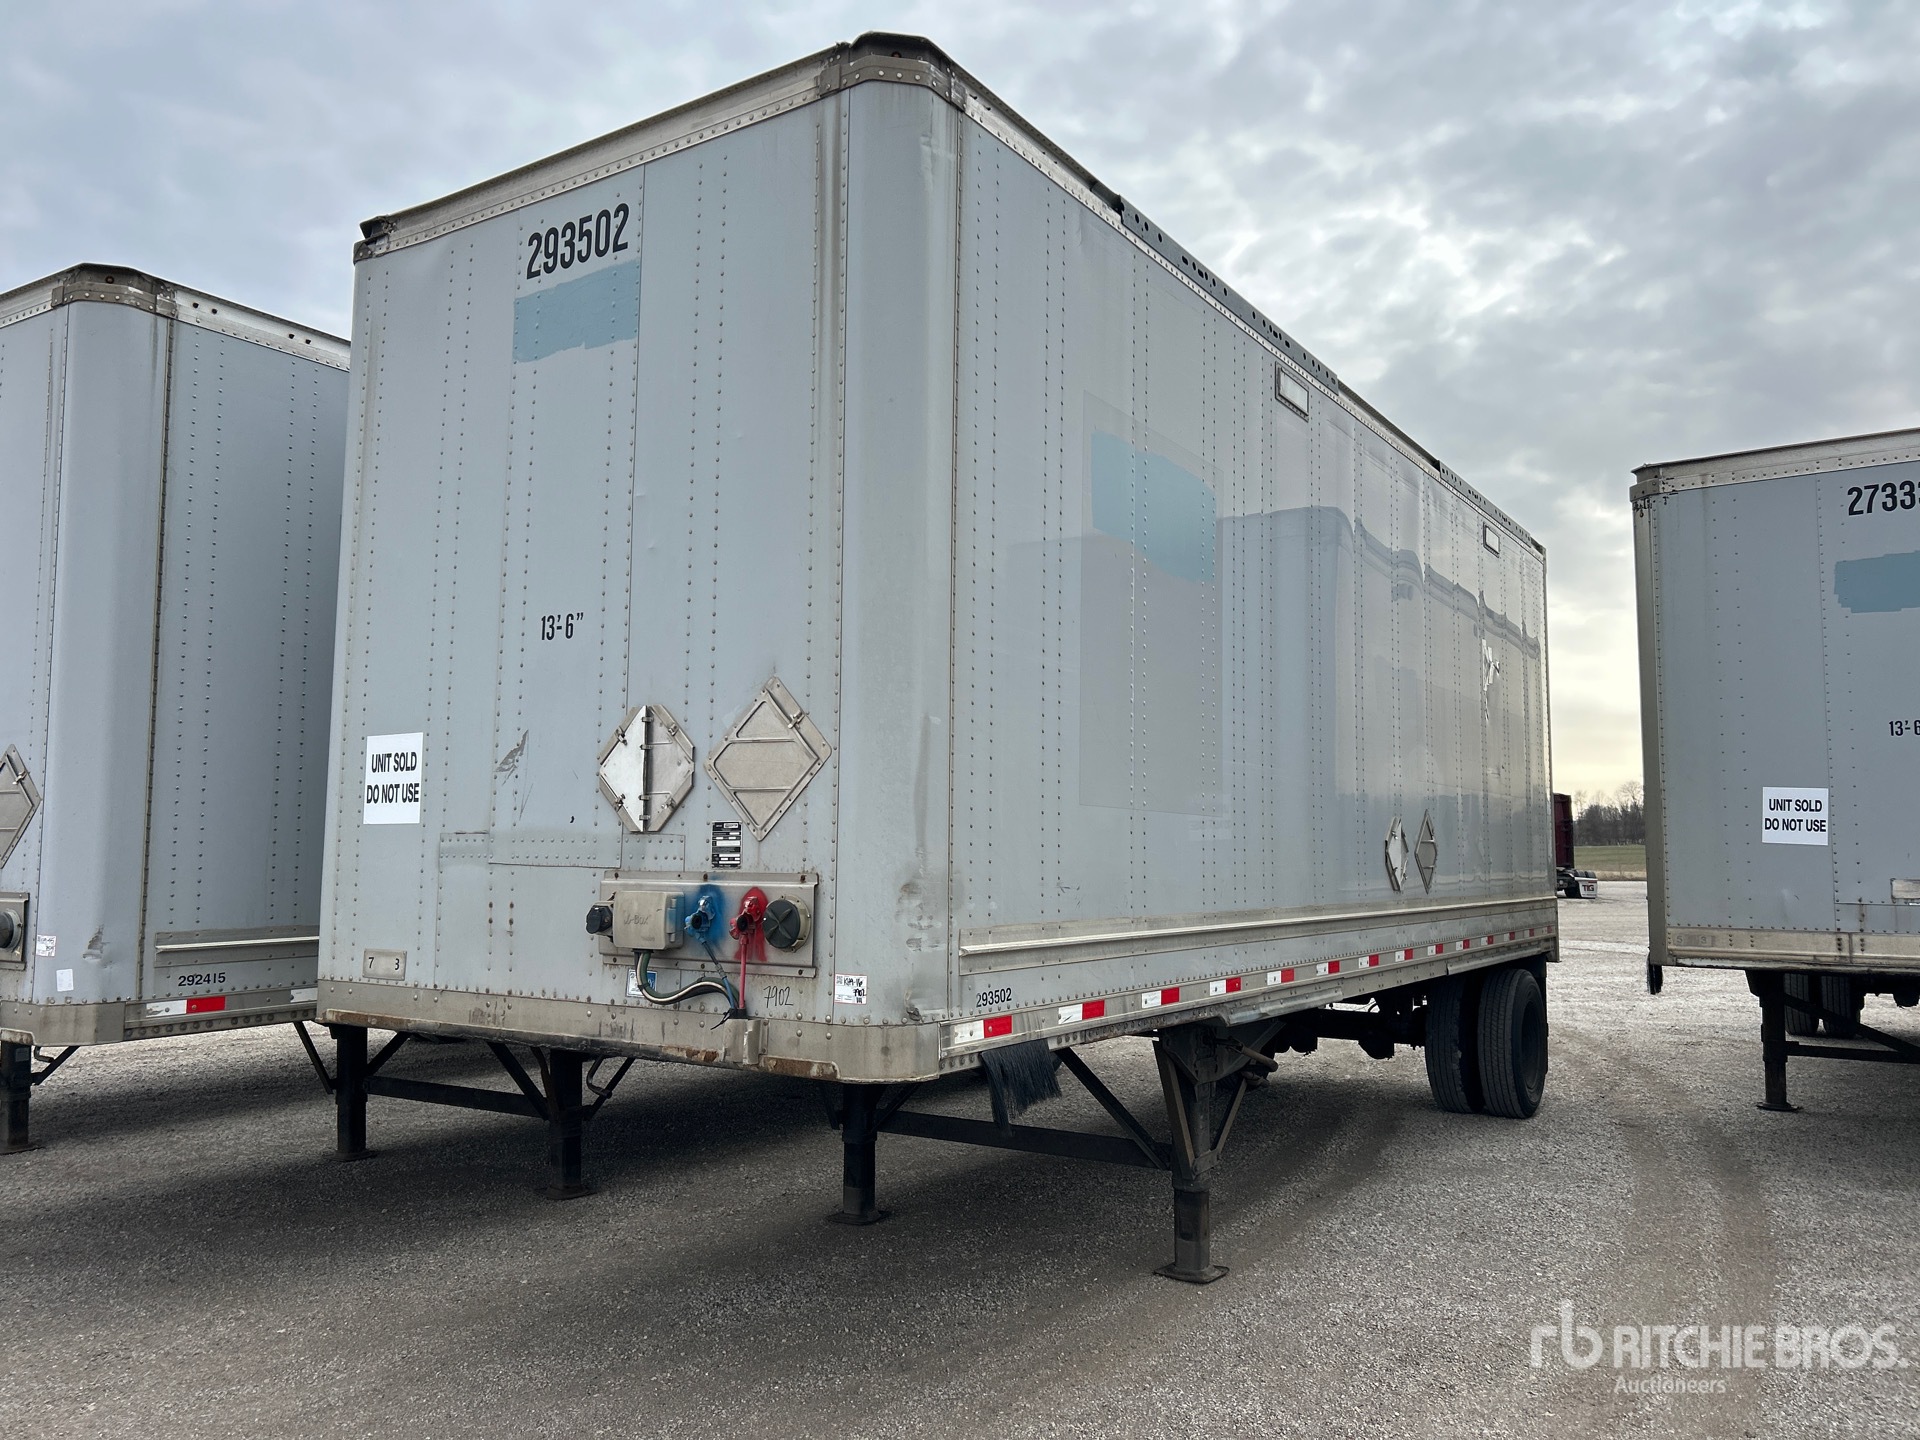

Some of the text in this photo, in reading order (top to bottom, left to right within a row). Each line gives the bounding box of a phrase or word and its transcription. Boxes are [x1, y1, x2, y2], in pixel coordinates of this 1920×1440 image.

[526, 203, 629, 280] 293502
[1847, 480, 1920, 516] 2733
[371, 751, 417, 773] UNIT SOLD
[366, 782, 420, 804] DO NOT USE
[1768, 798, 1823, 812] UNIT SOLD
[1764, 817, 1827, 833] DO NOT USE
[368, 956, 400, 971] 7 3
[178, 971, 227, 987] 292415
[762, 985, 794, 1009] 7902
[976, 987, 1012, 1008] 293502
